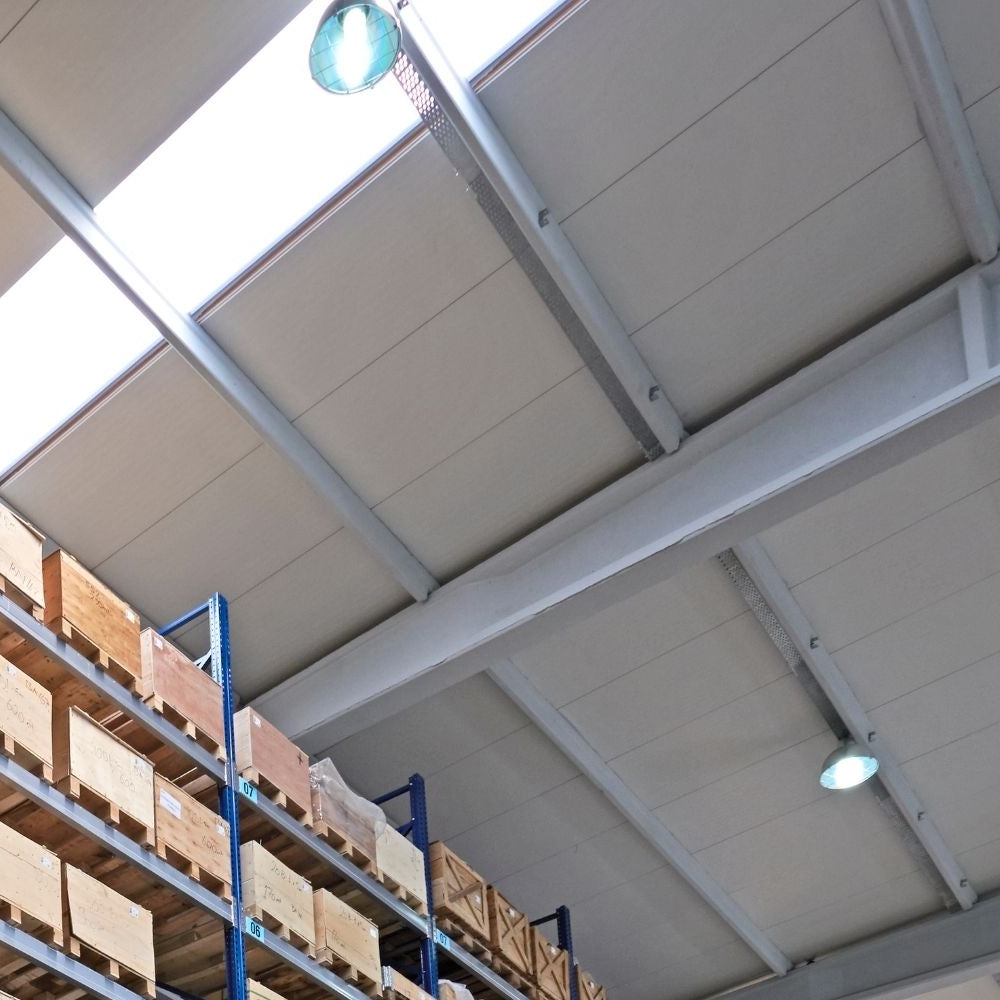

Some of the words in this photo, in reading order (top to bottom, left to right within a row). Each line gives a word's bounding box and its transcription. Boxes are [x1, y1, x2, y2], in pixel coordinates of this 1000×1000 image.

[243, 782, 253, 798] 07
[250, 921, 261, 938] 06
[440, 933, 447, 945] 07
